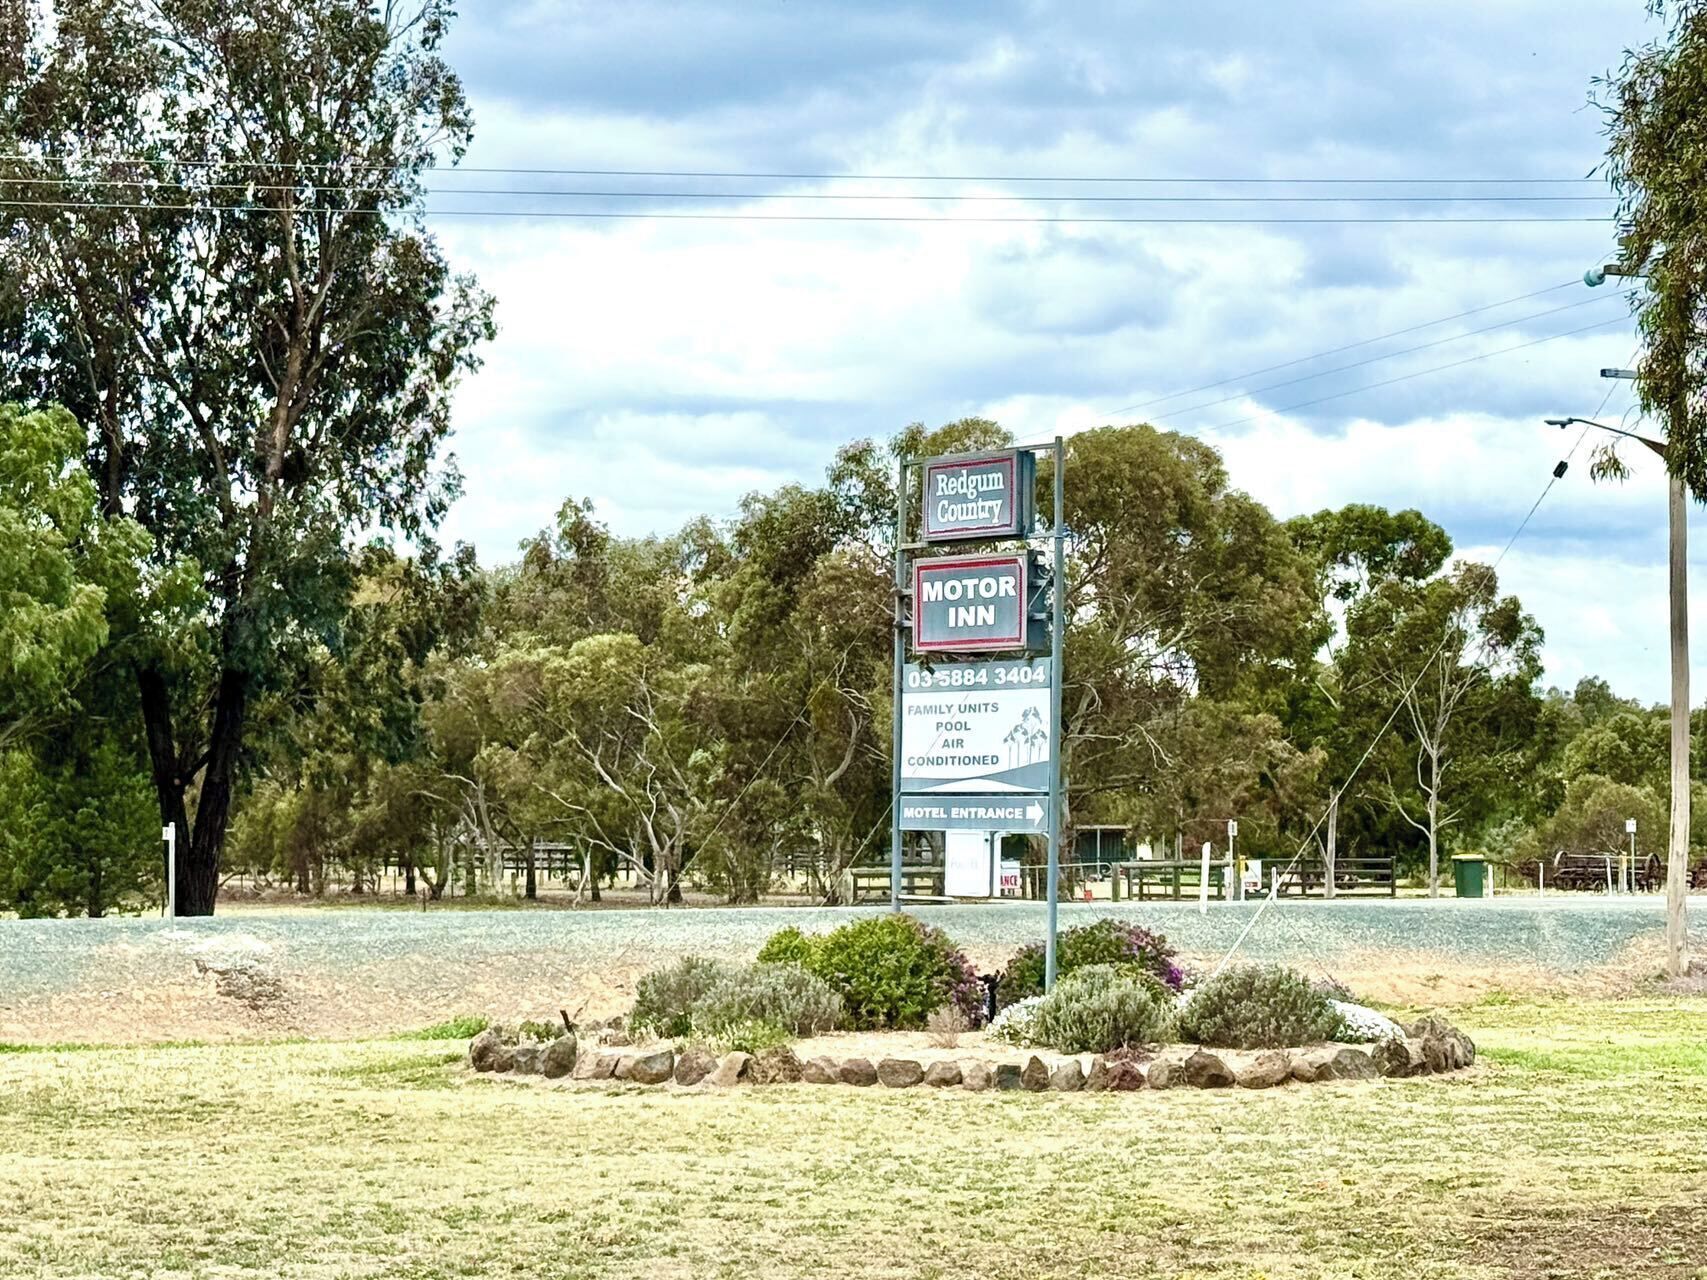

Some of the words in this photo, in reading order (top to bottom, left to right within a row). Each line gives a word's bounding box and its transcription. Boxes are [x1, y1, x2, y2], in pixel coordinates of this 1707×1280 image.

[936, 469, 1004, 499] Redgum
[937, 499, 1003, 524] Country
[922, 576, 1016, 602] MOTOR
[948, 605, 995, 628] INN
[994, 665, 1046, 685] 3404
[908, 704, 953, 715] FAMILY
[958, 702, 999, 714] UNITS
[936, 721, 971, 732] POOL
[941, 738, 964, 749] AIR
[907, 754, 999, 767] CONDITIONED
[904, 808, 947, 819] MOTEL
[952, 807, 1023, 819] ENTRANCE
